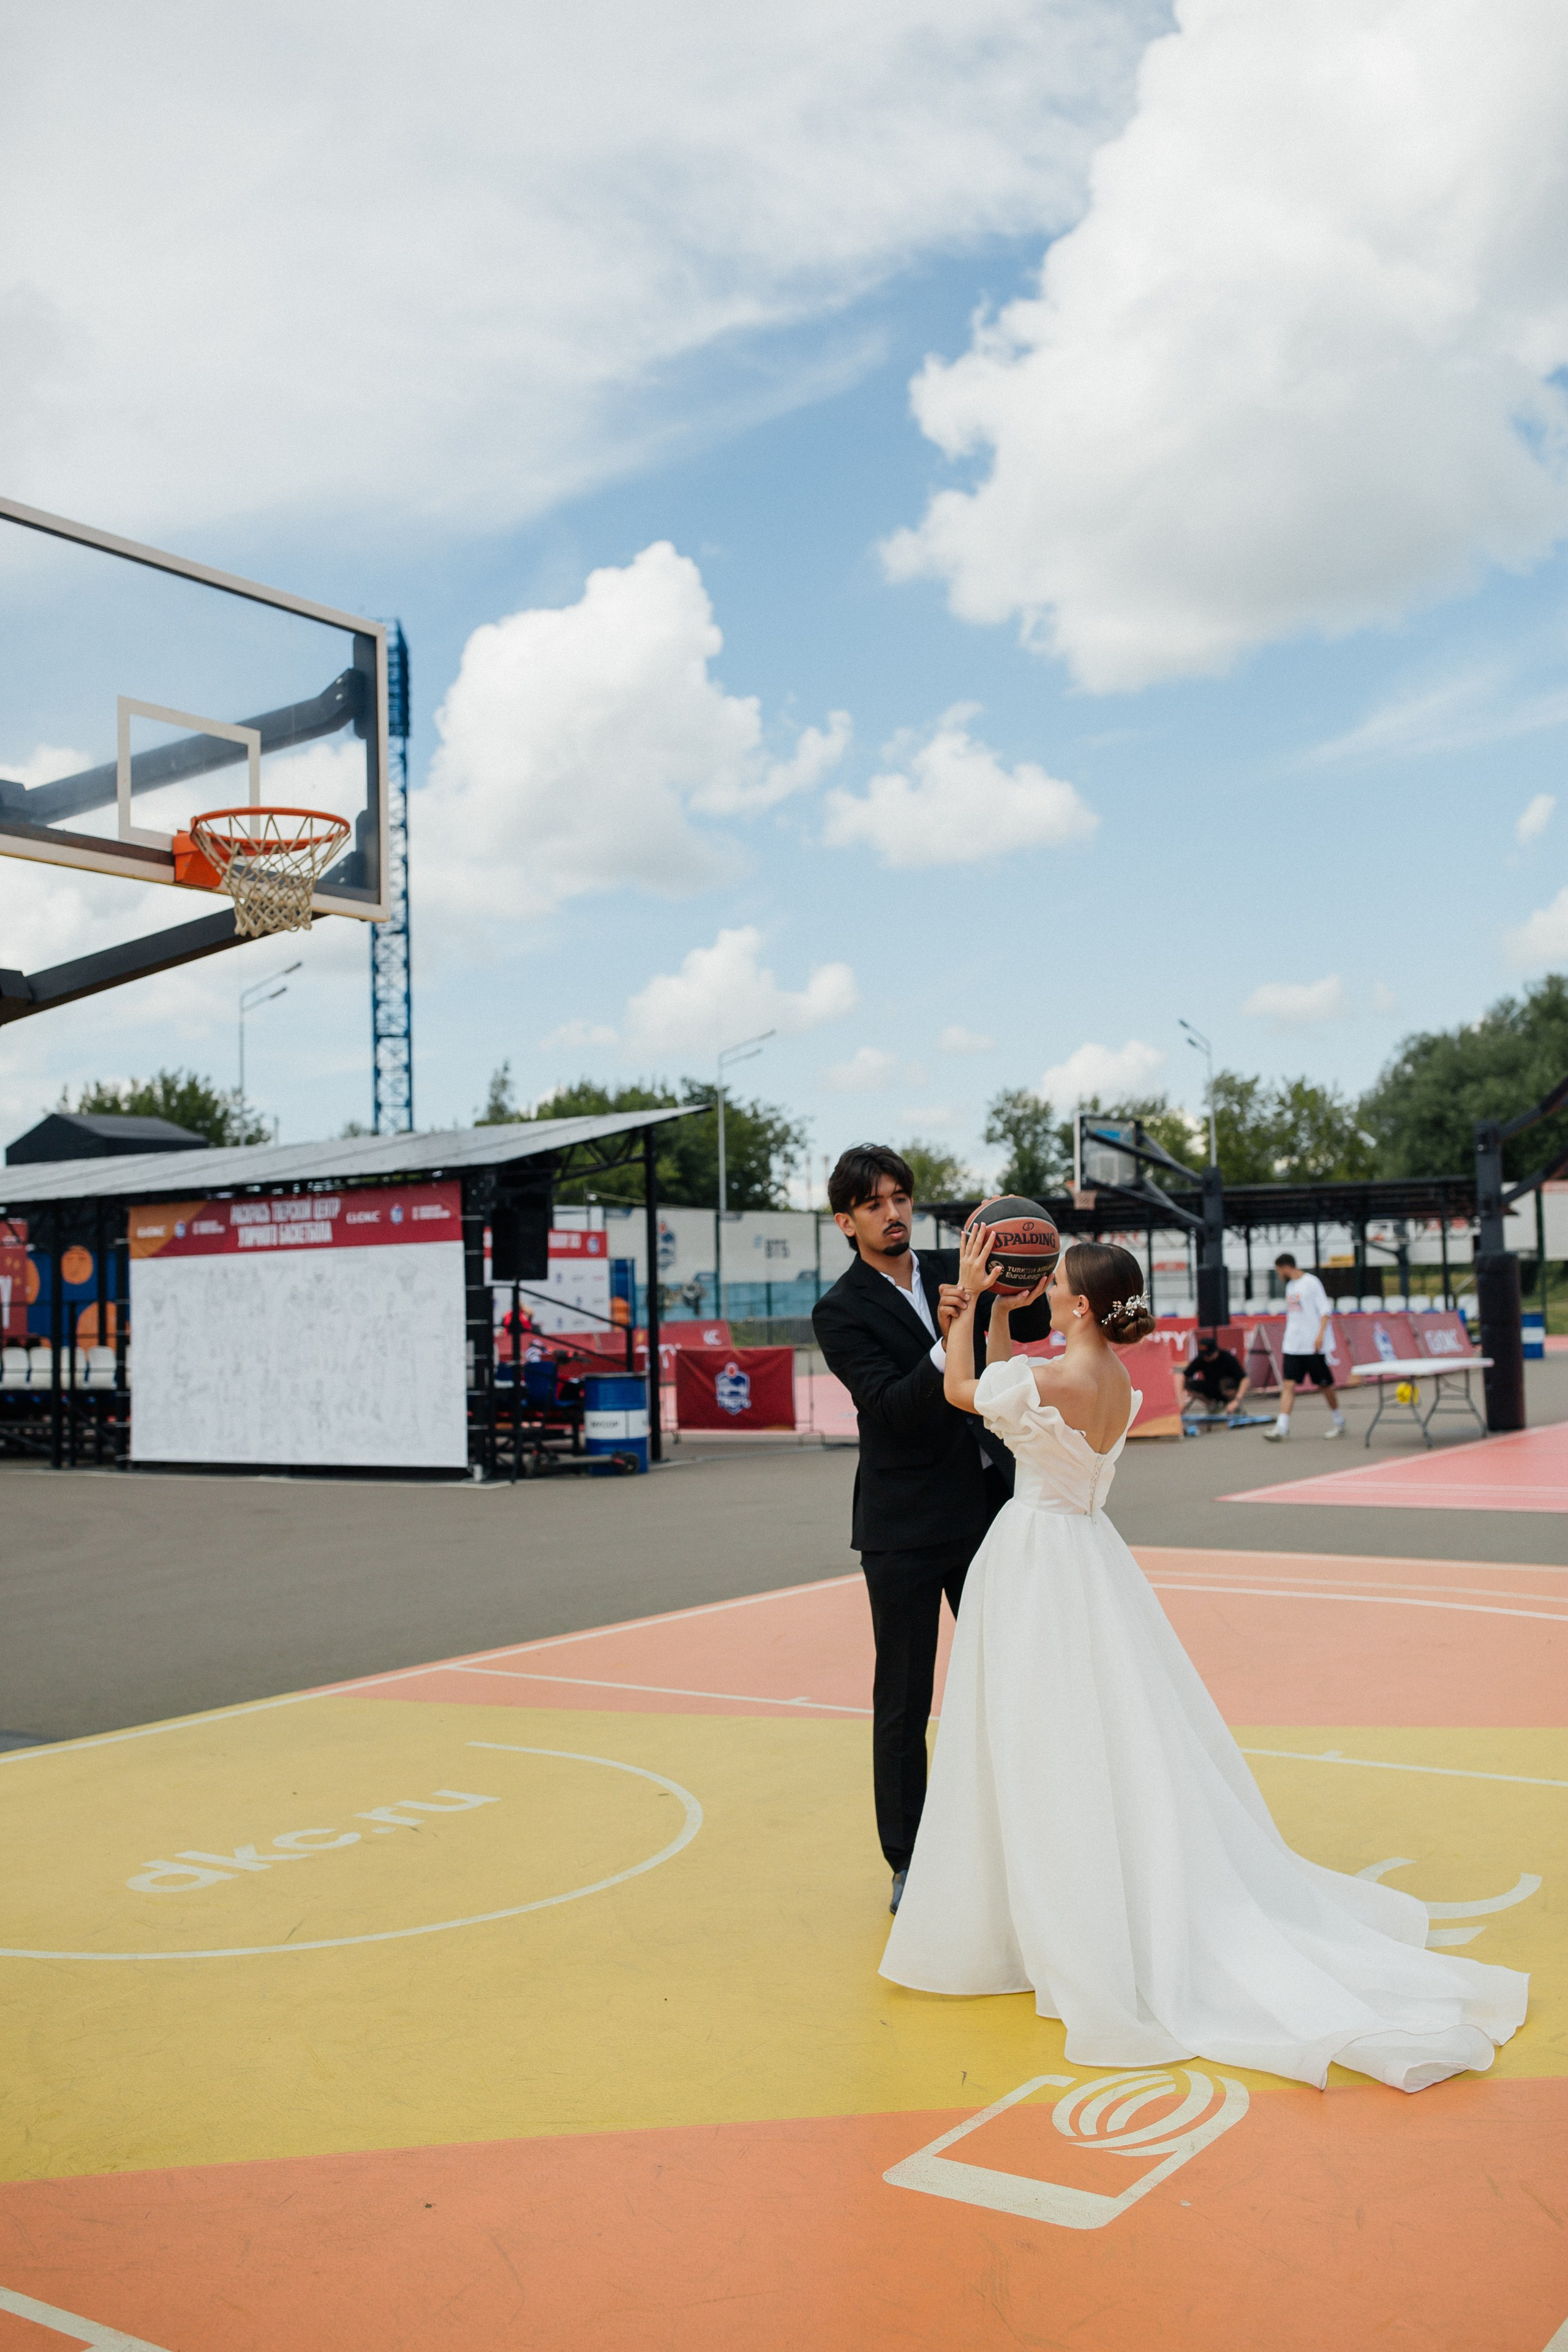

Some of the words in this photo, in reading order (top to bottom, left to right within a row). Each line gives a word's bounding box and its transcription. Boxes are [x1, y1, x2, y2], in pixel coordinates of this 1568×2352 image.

[995, 1232, 1056, 1249] SPALDING
[1005, 1272, 1047, 1281] EuroLeag
[126, 1789, 502, 1893] dkc.ru
